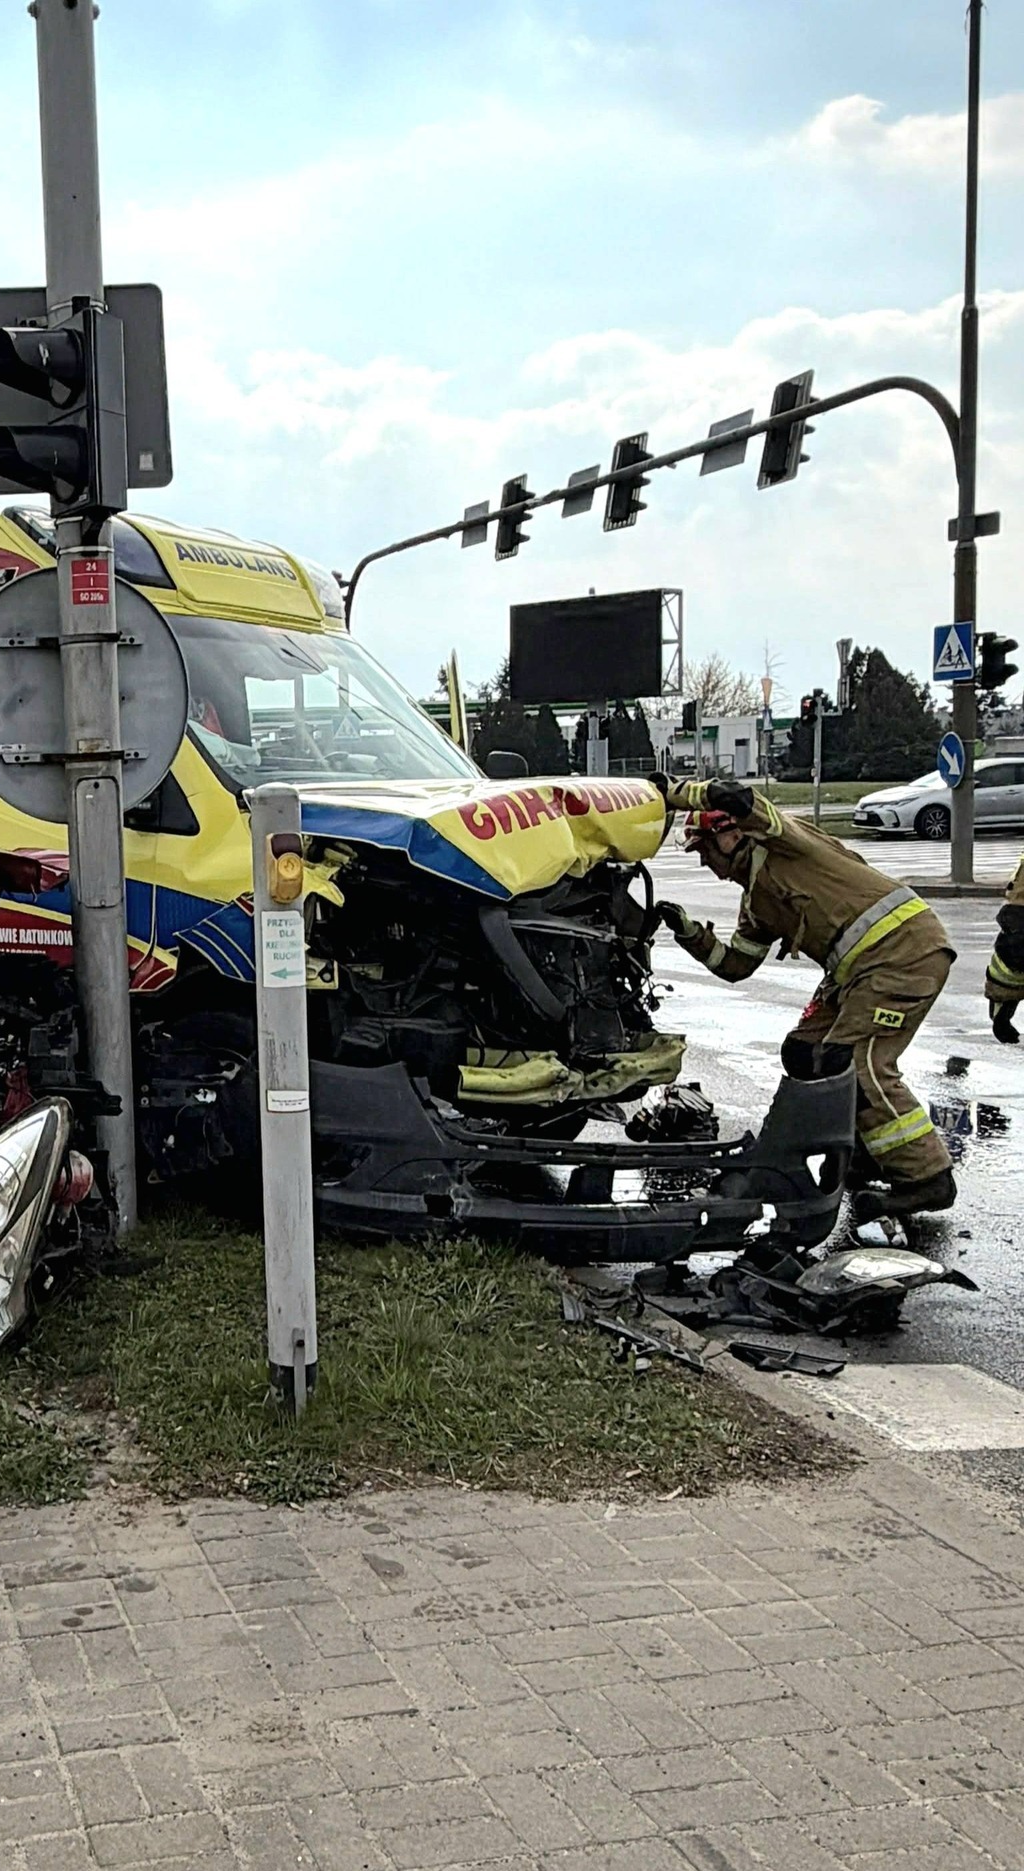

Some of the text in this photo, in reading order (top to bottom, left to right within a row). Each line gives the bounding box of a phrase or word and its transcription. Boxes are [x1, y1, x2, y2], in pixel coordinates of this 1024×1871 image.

[85, 562, 97, 571] 24
[174, 541, 297, 581] AMBULANS
[279, 929, 296, 938] DLA
[877, 1011, 901, 1025] PSP
